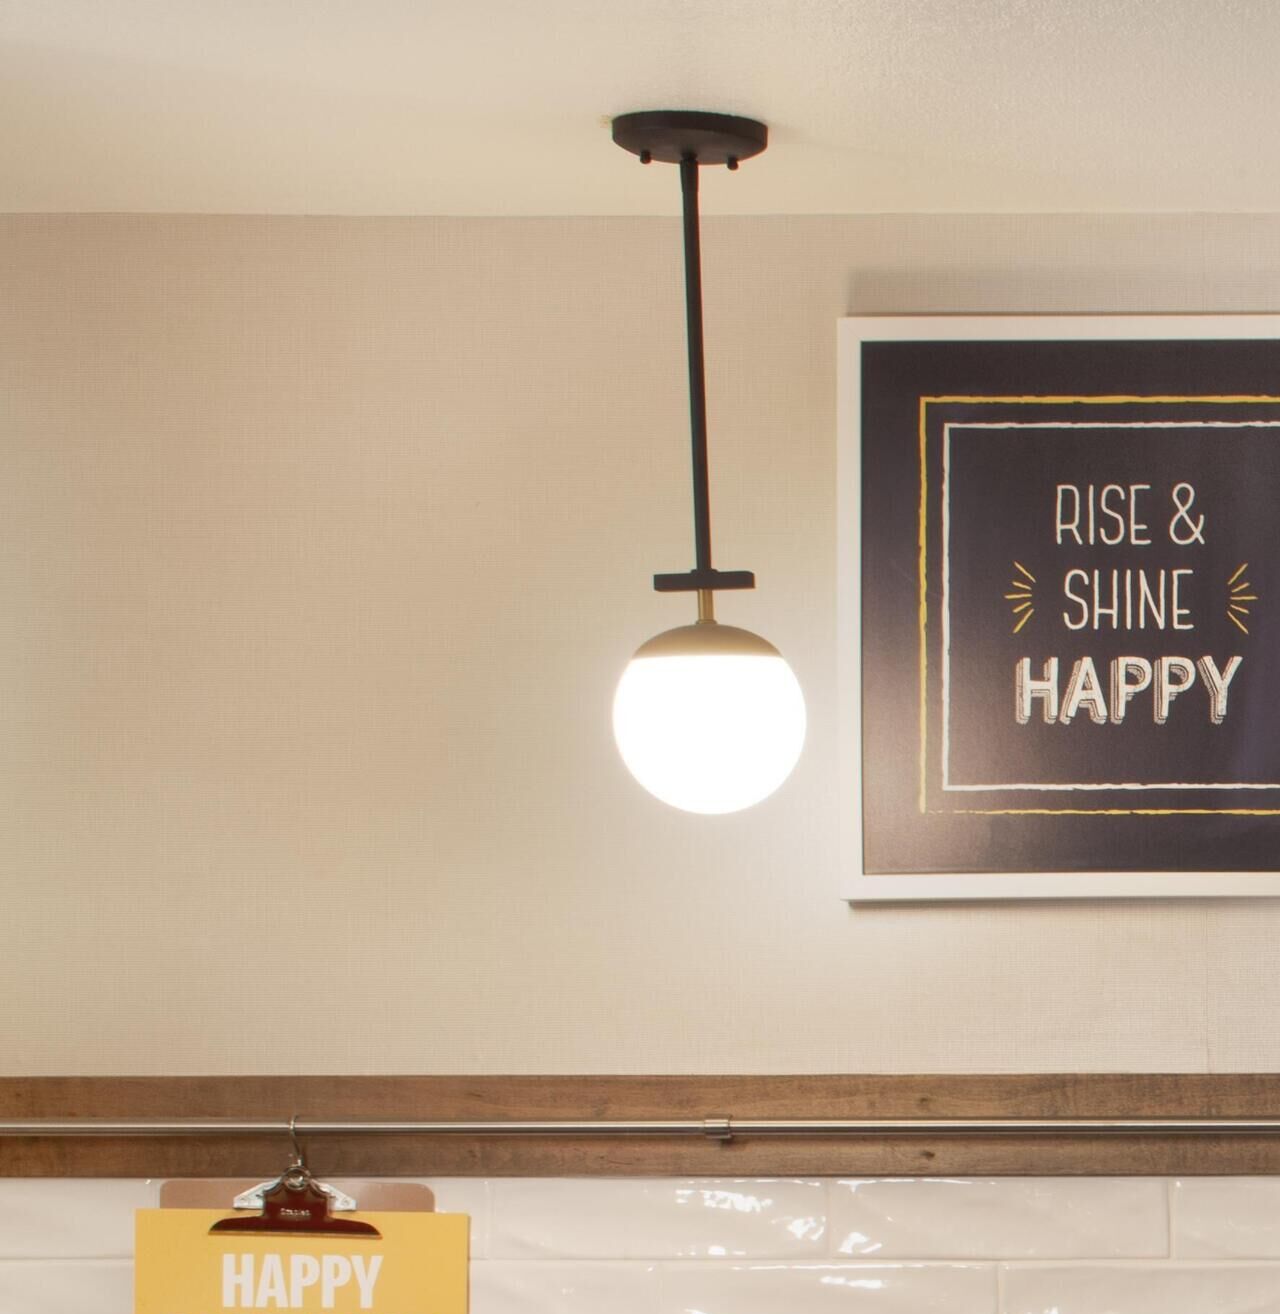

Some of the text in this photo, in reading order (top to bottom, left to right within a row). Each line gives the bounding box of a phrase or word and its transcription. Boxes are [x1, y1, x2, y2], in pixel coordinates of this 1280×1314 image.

[1055, 482, 1205, 545] RISE &
[1063, 569, 1194, 630] SHINE
[1014, 655, 1243, 725] HAPPY
[222, 1253, 384, 1309] HAPPY
